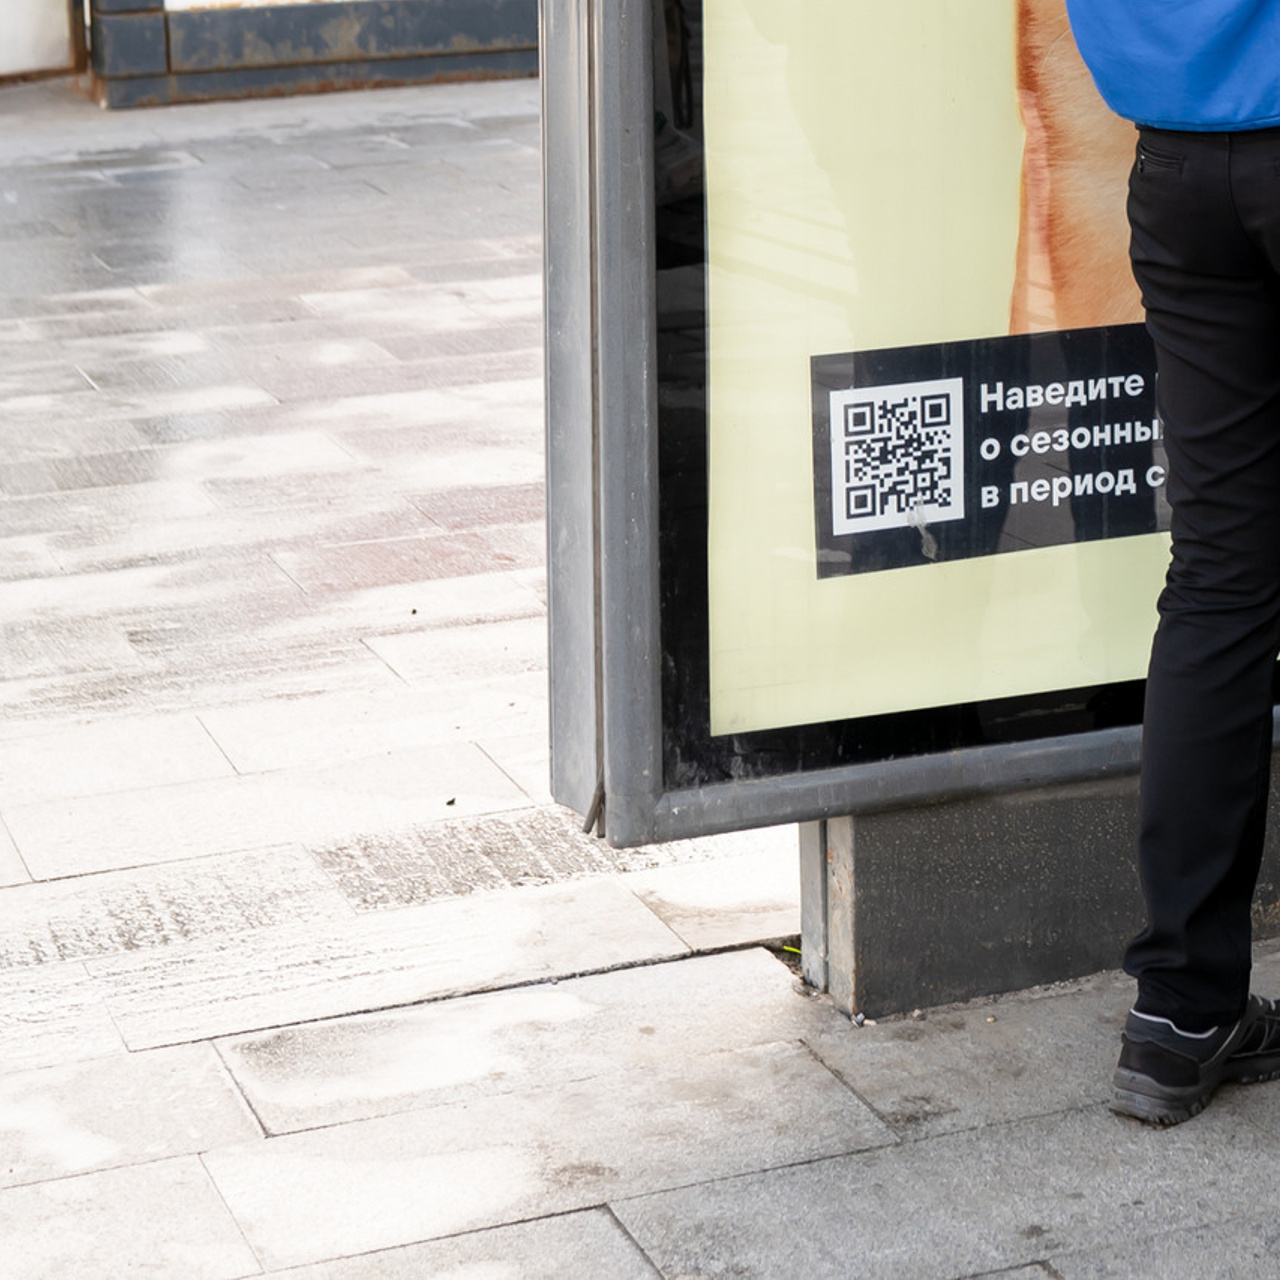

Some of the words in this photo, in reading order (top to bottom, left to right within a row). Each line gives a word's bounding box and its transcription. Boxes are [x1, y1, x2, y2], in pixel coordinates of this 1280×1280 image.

[980, 373, 1145, 413] Наведите
[980, 437, 1000, 461] о
[1010, 418, 1164, 457] сезонны
[981, 484, 1000, 509] в
[1010, 468, 1137, 507] период
[1146, 465, 1166, 488] с
